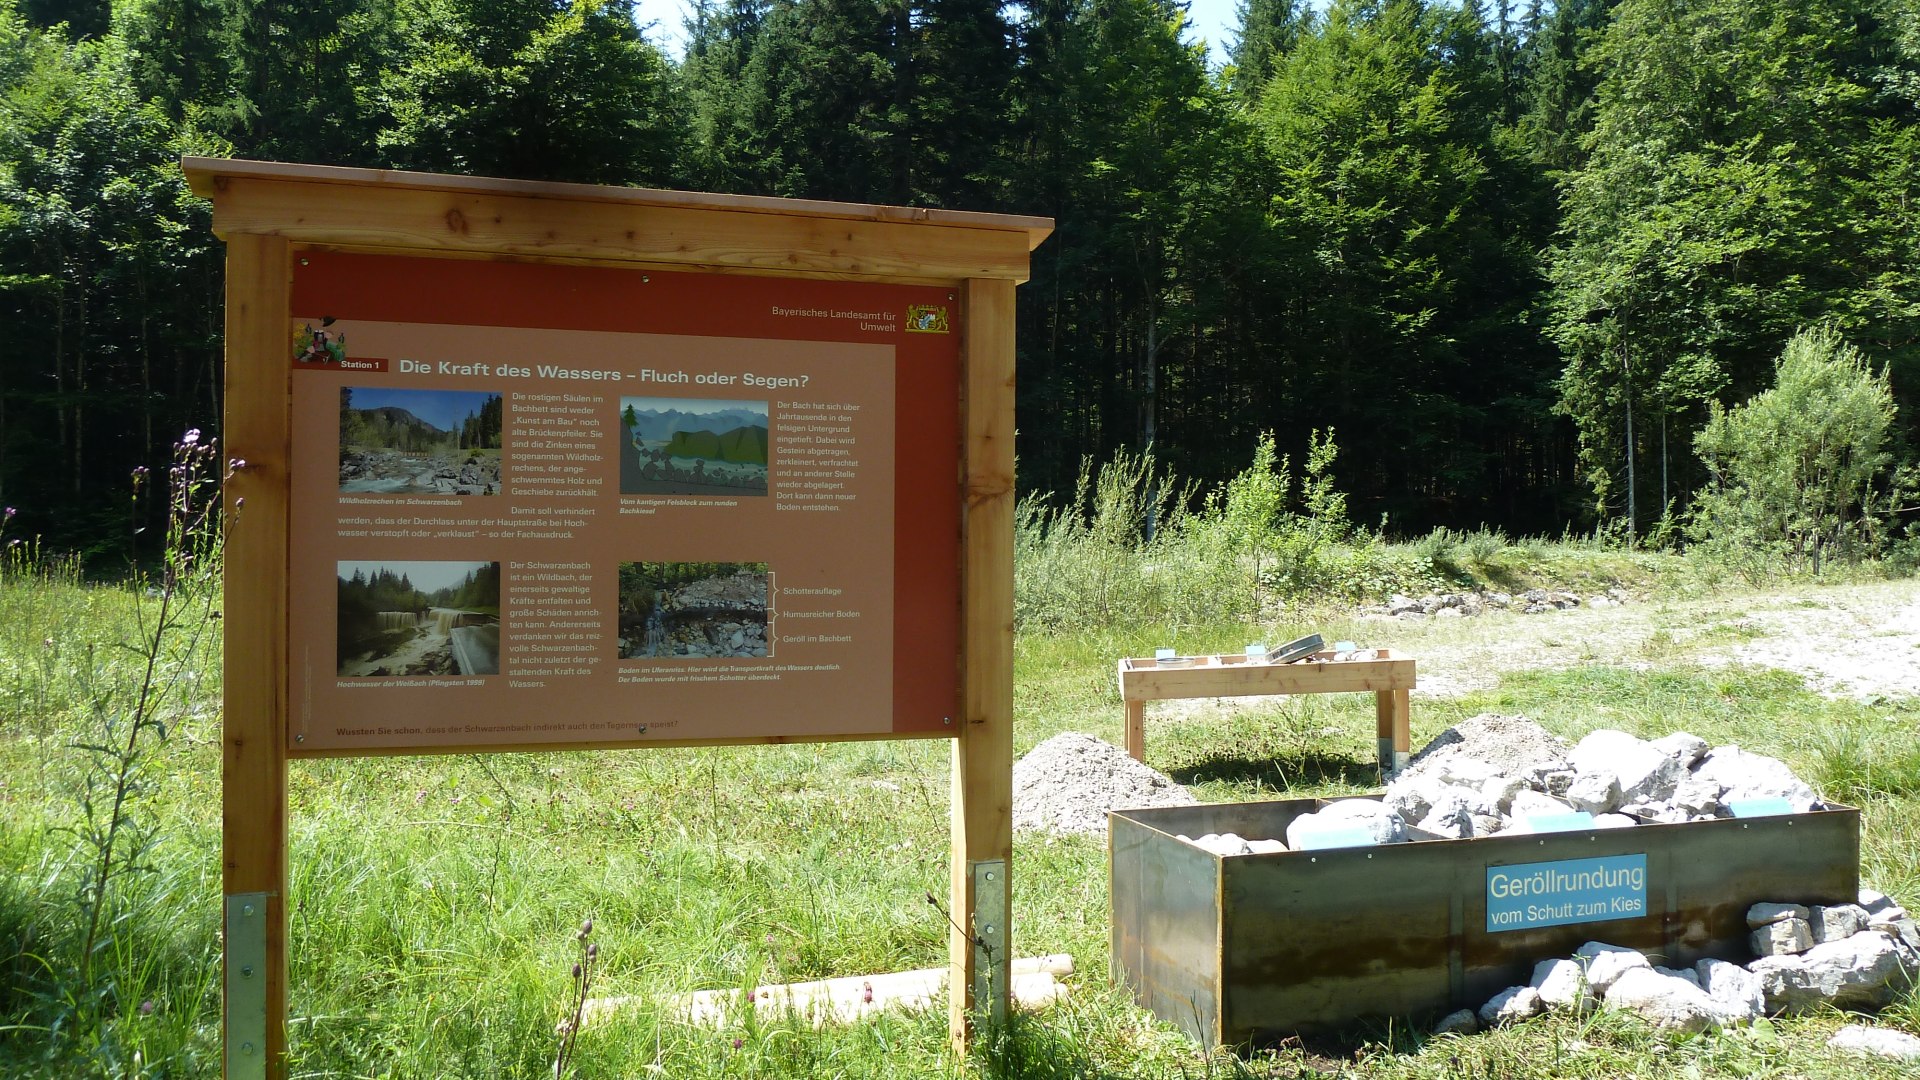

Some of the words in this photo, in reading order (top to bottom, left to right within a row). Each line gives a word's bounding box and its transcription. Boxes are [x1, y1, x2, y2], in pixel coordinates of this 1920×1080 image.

[772, 307, 828, 318] Bayerisches
[830, 309, 881, 320] Landesamt
[883, 312, 896, 321] für
[860, 322, 896, 332] Umwelt
[341, 361, 373, 369] Station
[400, 360, 431, 374] Die
[439, 361, 490, 376] Kraft
[496, 364, 531, 378] des
[537, 365, 621, 381] Wassers
[641, 369, 689, 384] Fluch
[695, 372, 737, 385] oder
[743, 373, 809, 389] Segen?
[512, 392, 526, 400] Die
[528, 393, 561, 403] rostigen
[563, 394, 591, 403] Säulen
[512, 404, 548, 413] Bachbett
[777, 401, 790, 409] Der
[777, 413, 827, 421] Jahrtausende
[777, 424, 806, 433] felsigen
[808, 425, 850, 434] Untergrund
[529, 429, 587, 438] Brückenpfeiler.
[590, 430, 603, 438] Sie
[816, 436, 837, 444] Dabei
[546, 441, 572, 449] Zinken
[566, 453, 604, 461] Wildholz-
[777, 458, 817, 466] zerkleinert,
[819, 459, 858, 467] verfrachtet
[512, 465, 546, 473] rechens,
[512, 488, 554, 496] Geschiebe
[556, 489, 599, 497] zurückhält.
[511, 507, 535, 515] Damit
[538, 507, 552, 515] soll
[803, 504, 840, 512] entstehen.
[497, 519, 547, 527] Hauptstraße
[371, 529, 409, 538] verstopft
[517, 531, 574, 539] Fachausdruck.
[527, 562, 591, 570] Schwarzenbach
[537, 574, 577, 582] Wildbach,
[551, 586, 590, 594] gewaltige
[784, 588, 842, 596] Schotterauflage
[510, 597, 535, 605] Kräfte
[537, 597, 573, 605] entfalten
[576, 597, 591, 605] und
[510, 609, 534, 618] große
[537, 609, 572, 617] Schäden
[574, 609, 602, 617] anrich-
[531, 644, 598, 652] Schwarzenbach-
[509, 680, 546, 688] Wassers.
[336, 728, 375, 736] Wussten
[1490, 866, 1644, 898] Geröllrundung
[1492, 910, 1522, 925] vom
[1527, 903, 1573, 921] Schutt
[1577, 902, 1606, 917] zum
[1612, 897, 1642, 913] Kies
